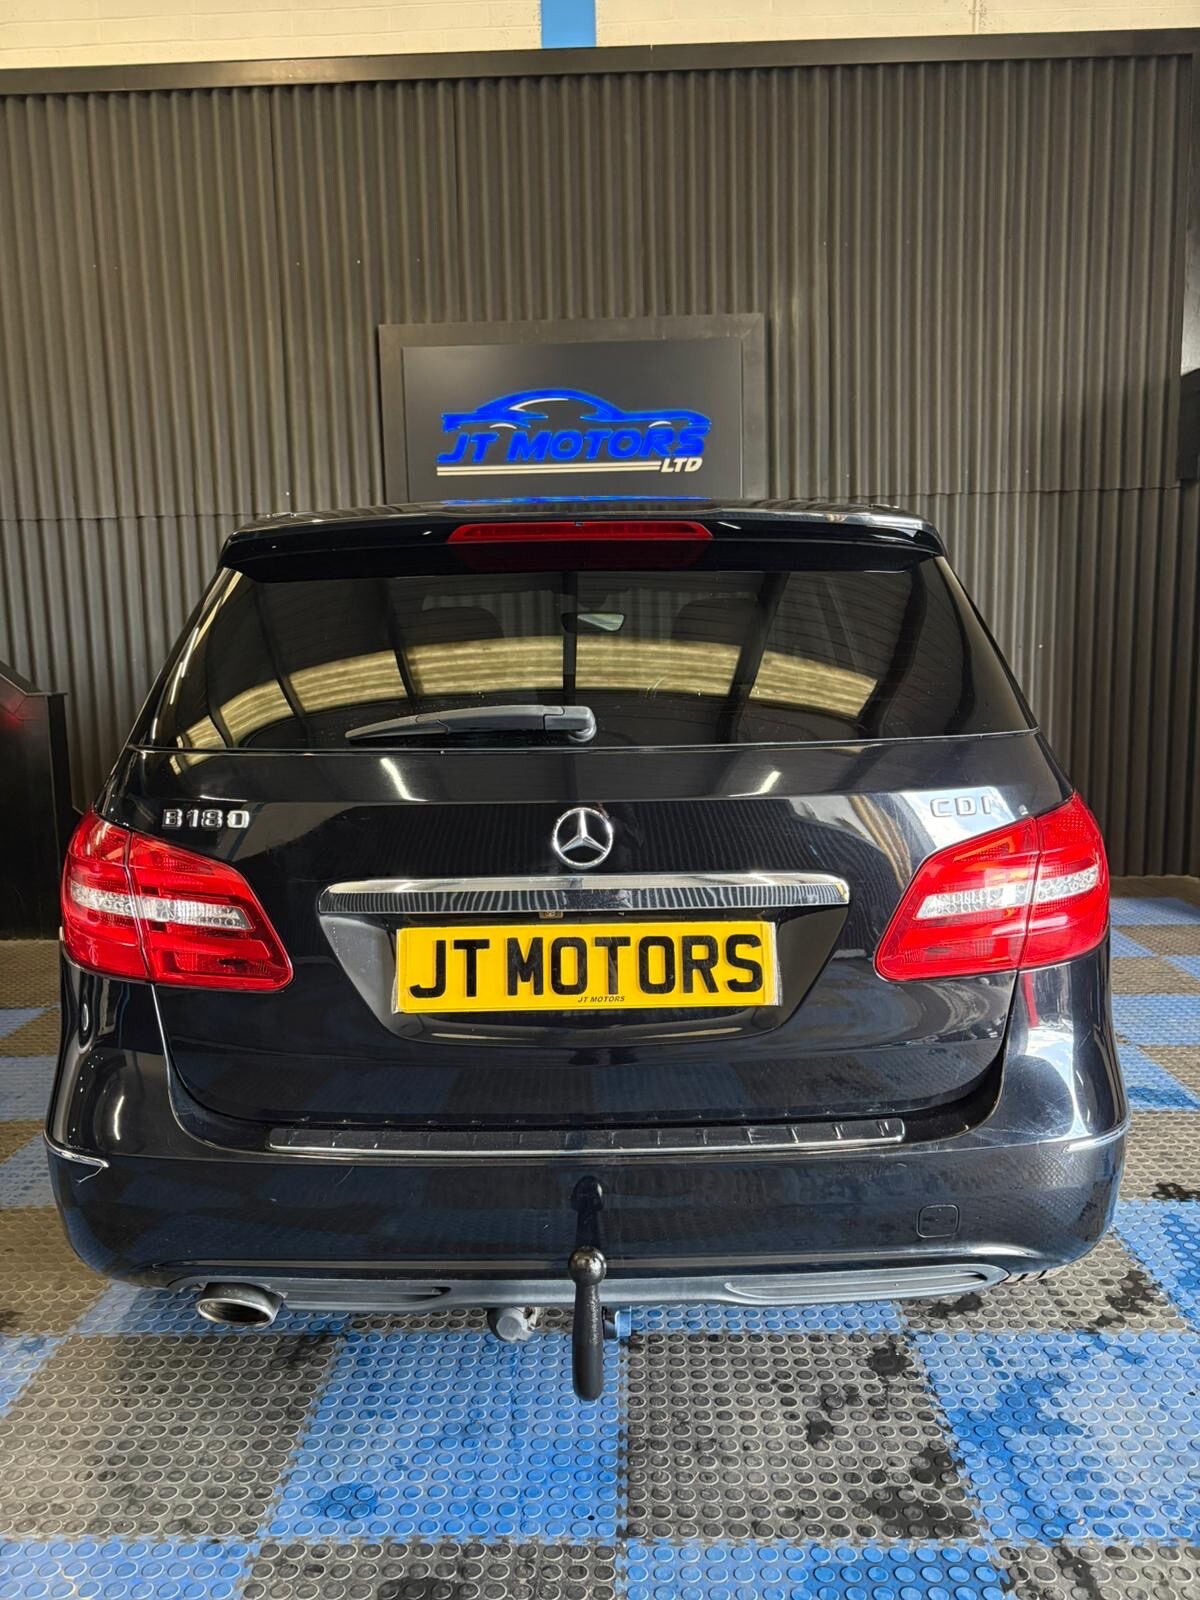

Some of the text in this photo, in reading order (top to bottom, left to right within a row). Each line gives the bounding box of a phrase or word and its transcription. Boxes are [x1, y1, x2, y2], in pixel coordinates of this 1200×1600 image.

[436, 427, 706, 463] JT MOTORS
[660, 457, 703, 473] LTD
[930, 796, 992, 818] CDI
[162, 808, 250, 829] B180
[409, 934, 763, 999] JT MOTORS
[590, 995, 625, 1003] MOTORS
